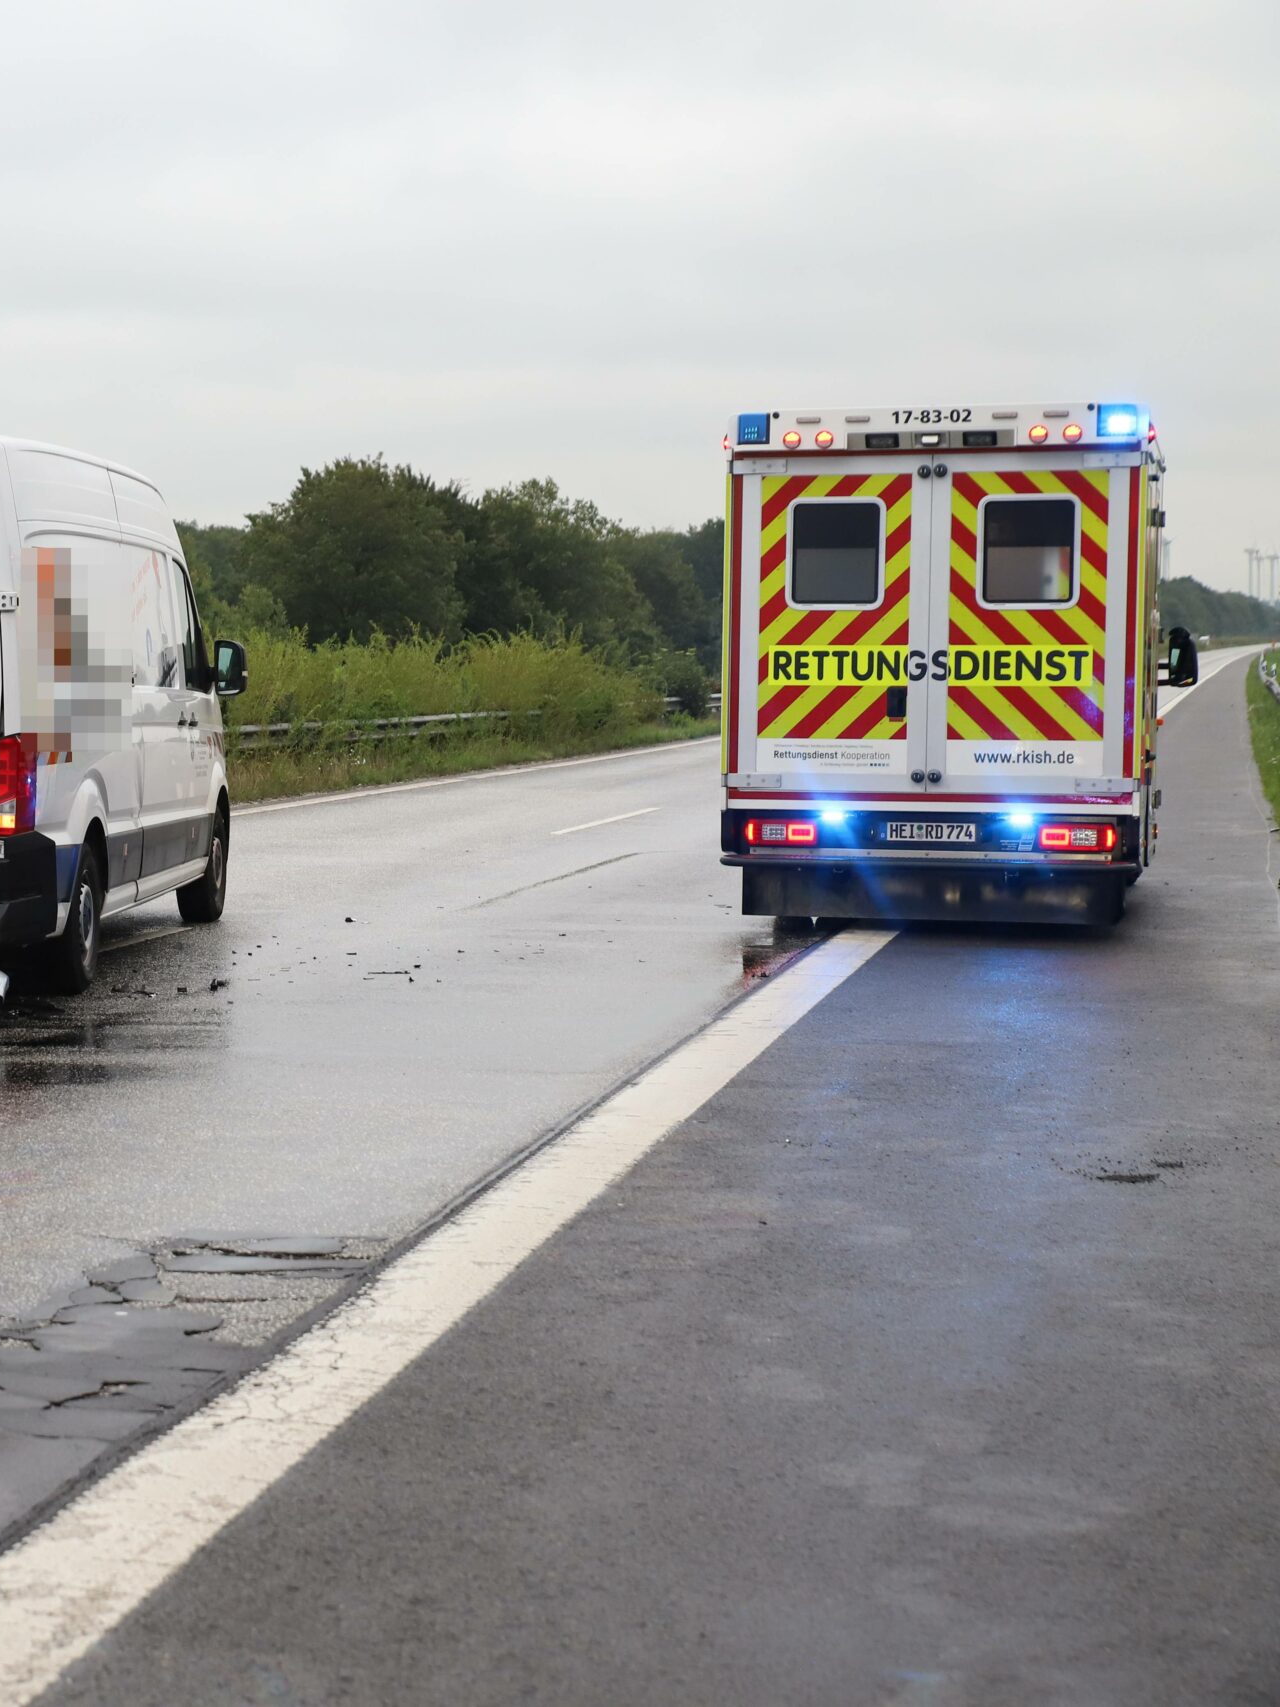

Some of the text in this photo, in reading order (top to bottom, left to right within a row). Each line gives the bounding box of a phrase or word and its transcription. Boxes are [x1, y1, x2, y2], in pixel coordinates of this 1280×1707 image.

[892, 409, 972, 424] 17-83-02
[773, 650, 1090, 681] RETTUNGSDIENST
[773, 750, 890, 760] Rettungsdienst Kooperation
[974, 750, 1074, 764] www.rkish.de
[889, 824, 915, 839] HEI
[925, 824, 944, 839] RD
[947, 825, 973, 839] 774
